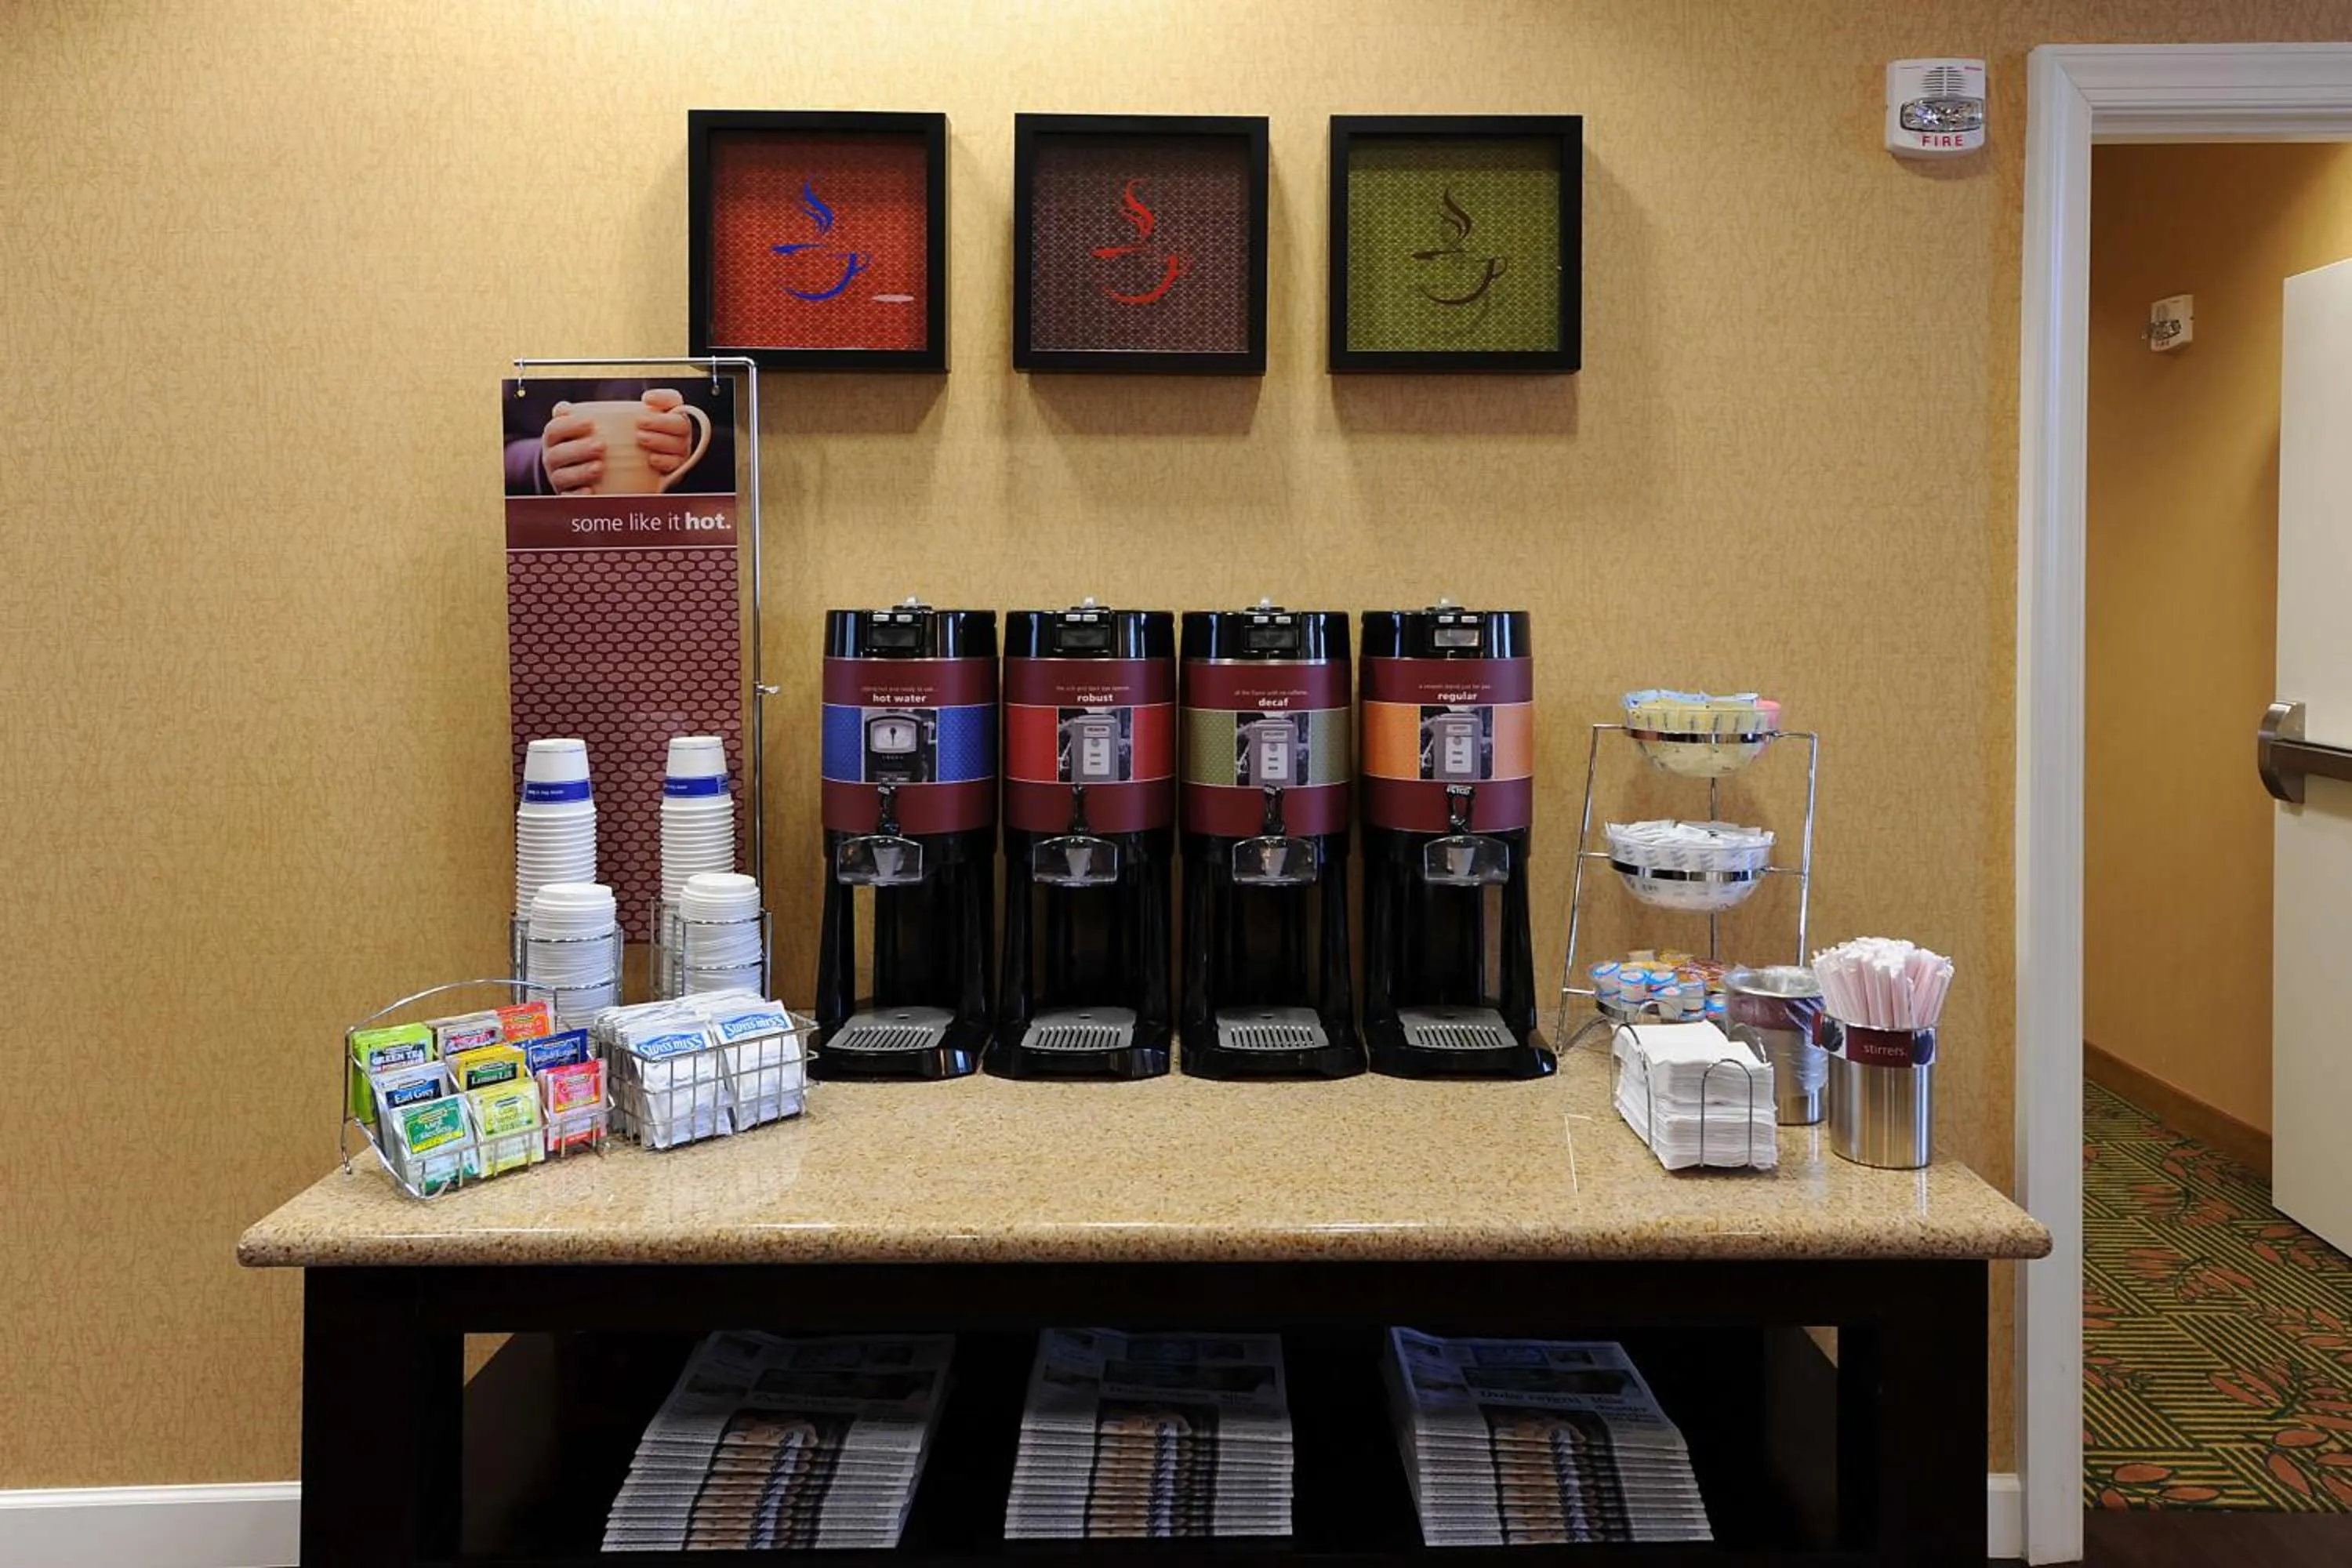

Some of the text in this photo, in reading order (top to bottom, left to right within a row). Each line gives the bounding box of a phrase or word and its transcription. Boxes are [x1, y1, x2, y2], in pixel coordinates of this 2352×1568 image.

[1922, 135, 1964, 147] FIRE
[572, 511, 732, 532] some like it hot.
[873, 693, 927, 703] hot water
[1076, 693, 1113, 702] robust
[1258, 697, 1290, 706] decaf
[1437, 691, 1478, 704] regular
[724, 1018, 755, 1036] Swiss
[639, 1041, 673, 1057] Swiss
[372, 1049, 424, 1066] GREEN TEA
[394, 1092, 413, 1105] Earl
